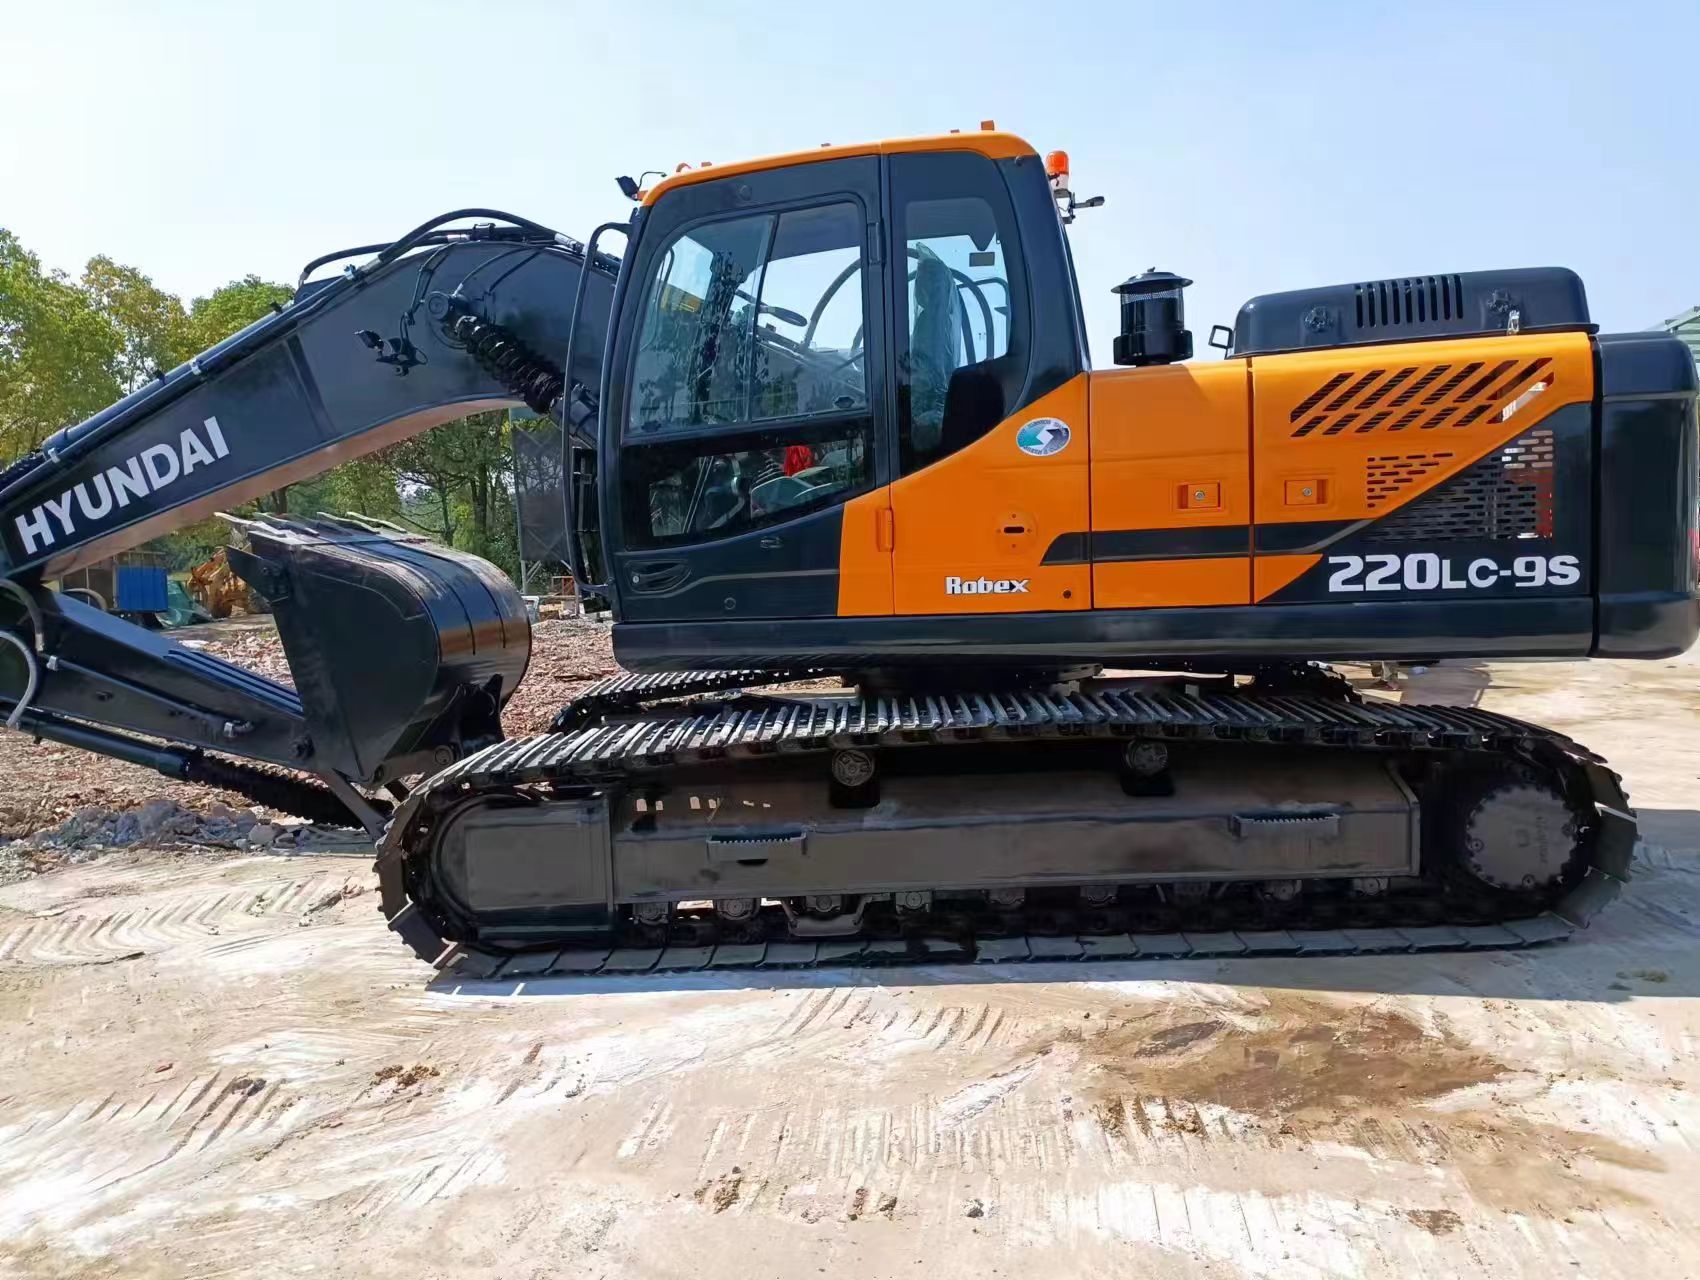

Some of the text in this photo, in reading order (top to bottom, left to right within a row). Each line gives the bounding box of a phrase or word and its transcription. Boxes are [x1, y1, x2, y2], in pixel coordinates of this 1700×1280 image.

[15, 416, 229, 555] HYUNDAI
[945, 576, 1030, 595] Robex
[1328, 553, 1581, 592] 220LC-9S
